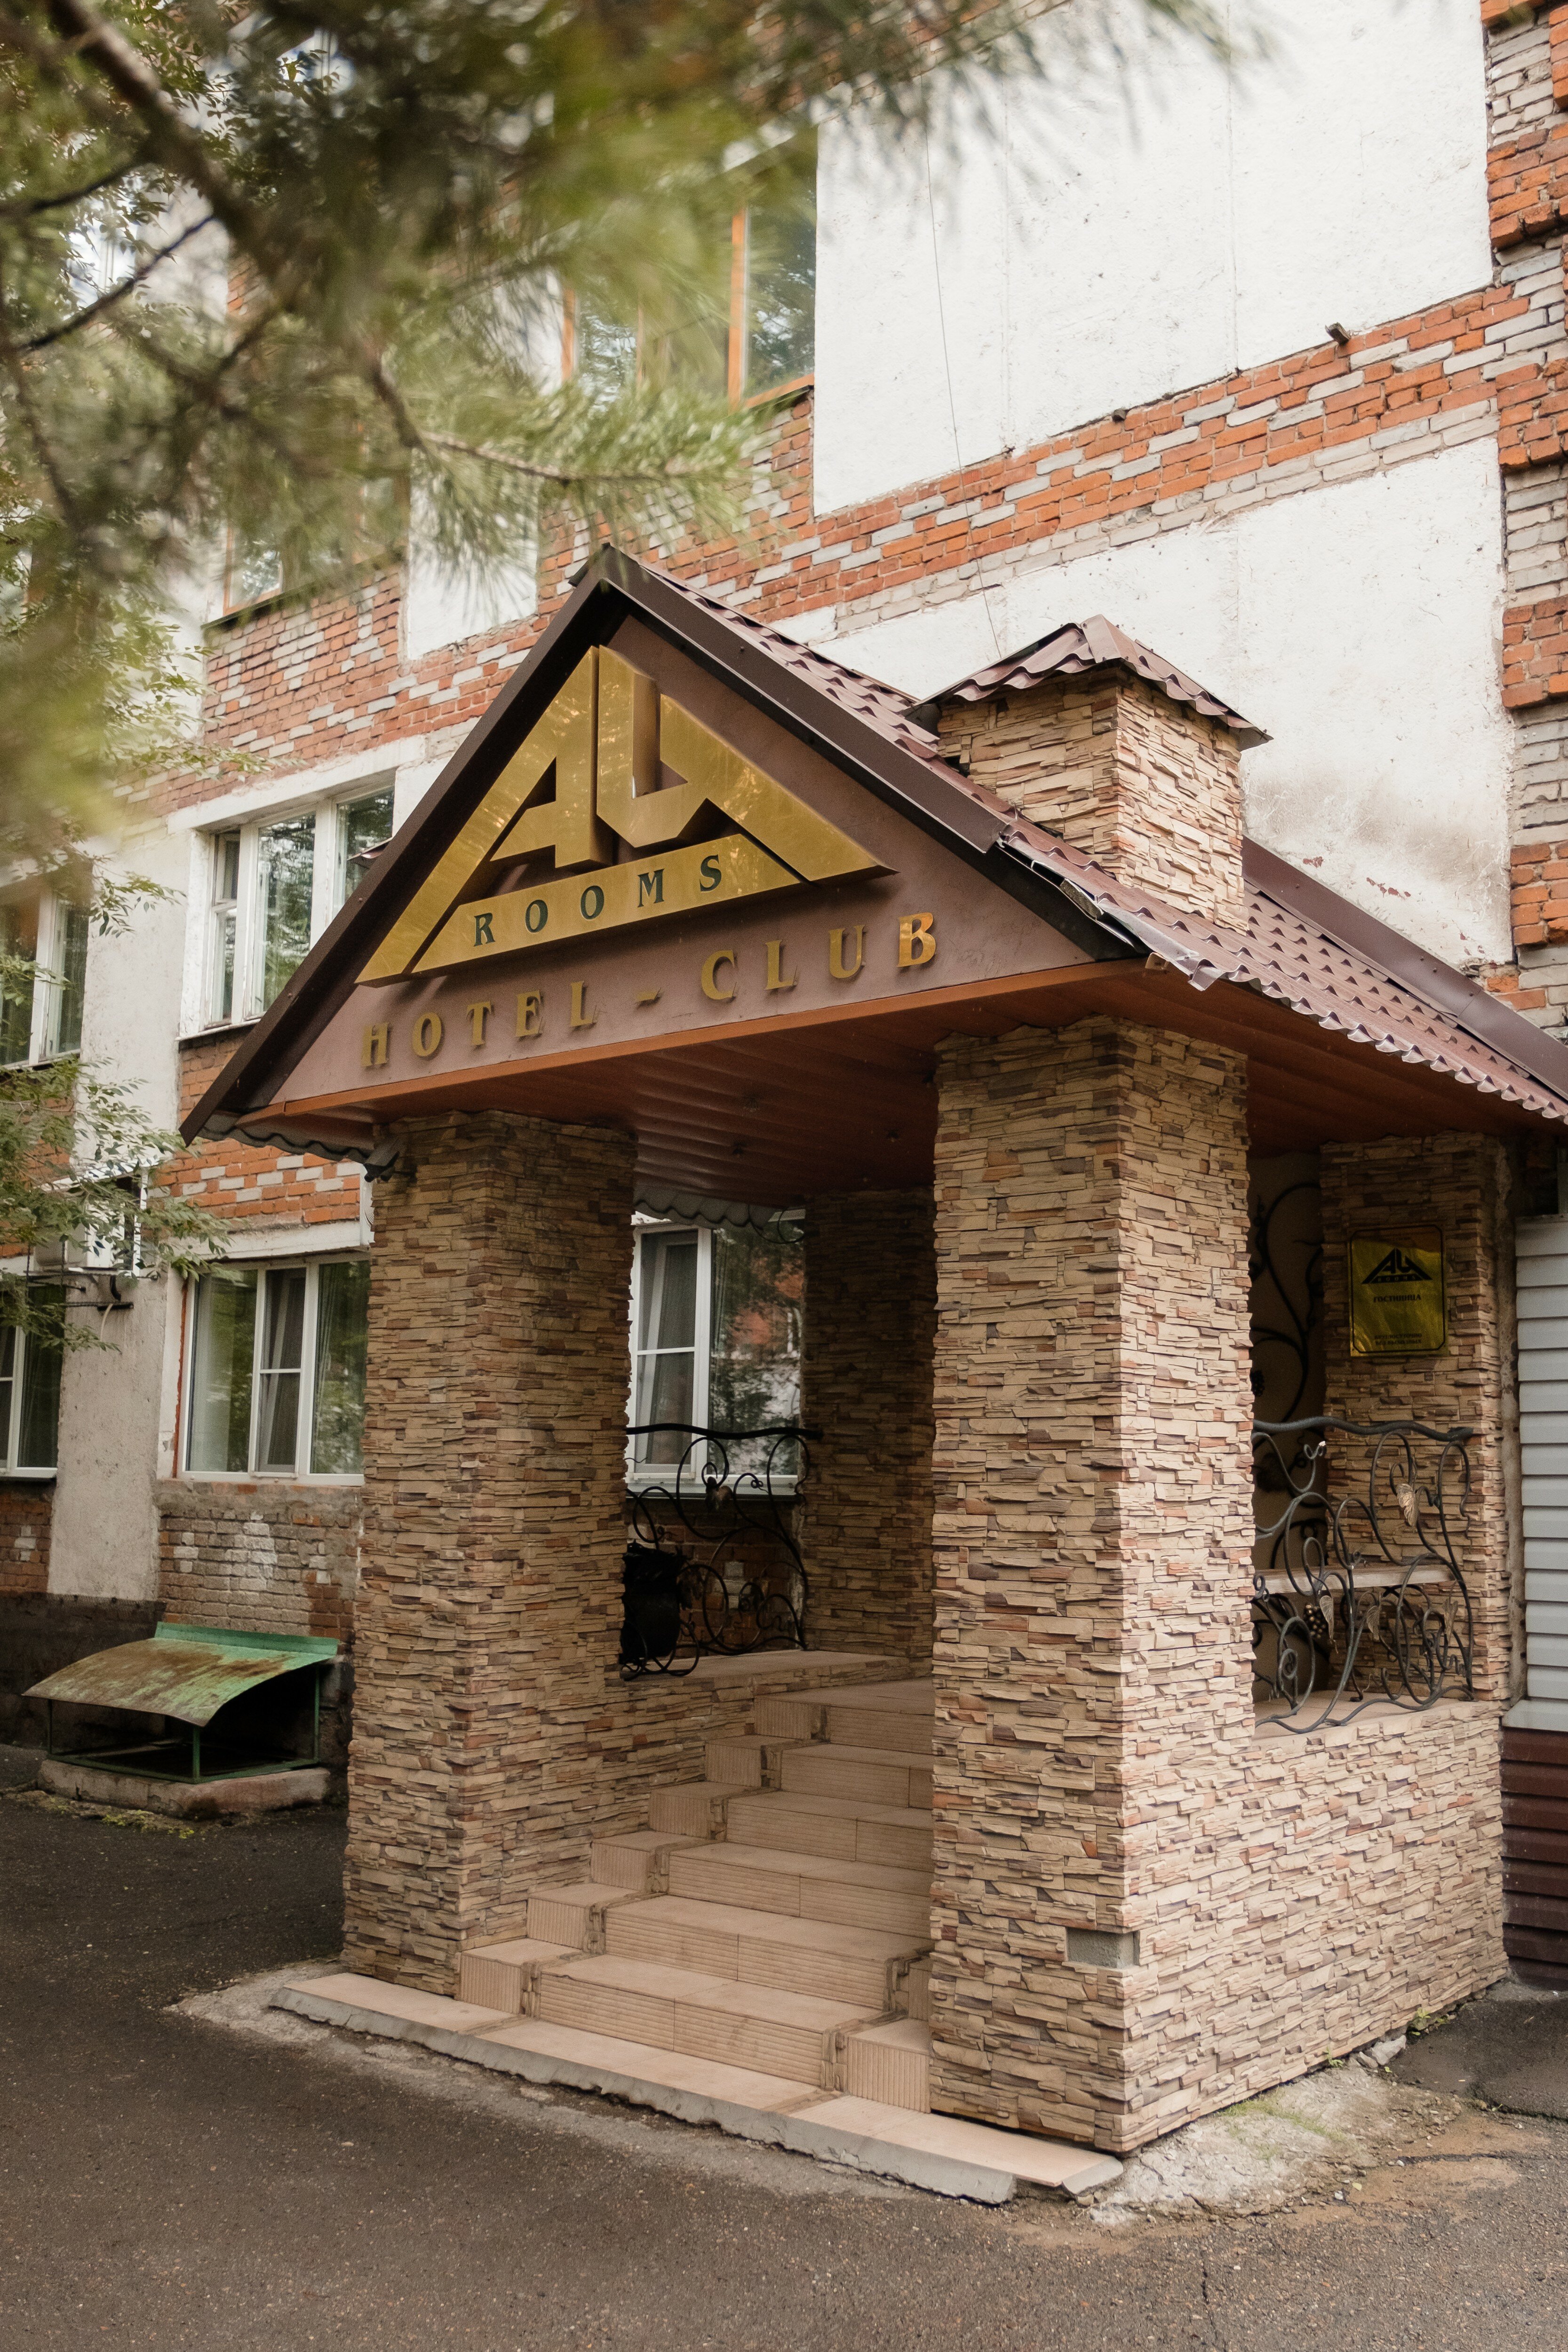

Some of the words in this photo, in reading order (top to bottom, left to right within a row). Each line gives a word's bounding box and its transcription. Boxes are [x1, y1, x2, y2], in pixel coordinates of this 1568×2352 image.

[473, 854, 722, 946] ROOMS
[361, 980, 597, 1068] HOTEL
[700, 912, 937, 1001] CLUB
[1373, 1294, 1421, 1303] ГОСТИНИЦА
